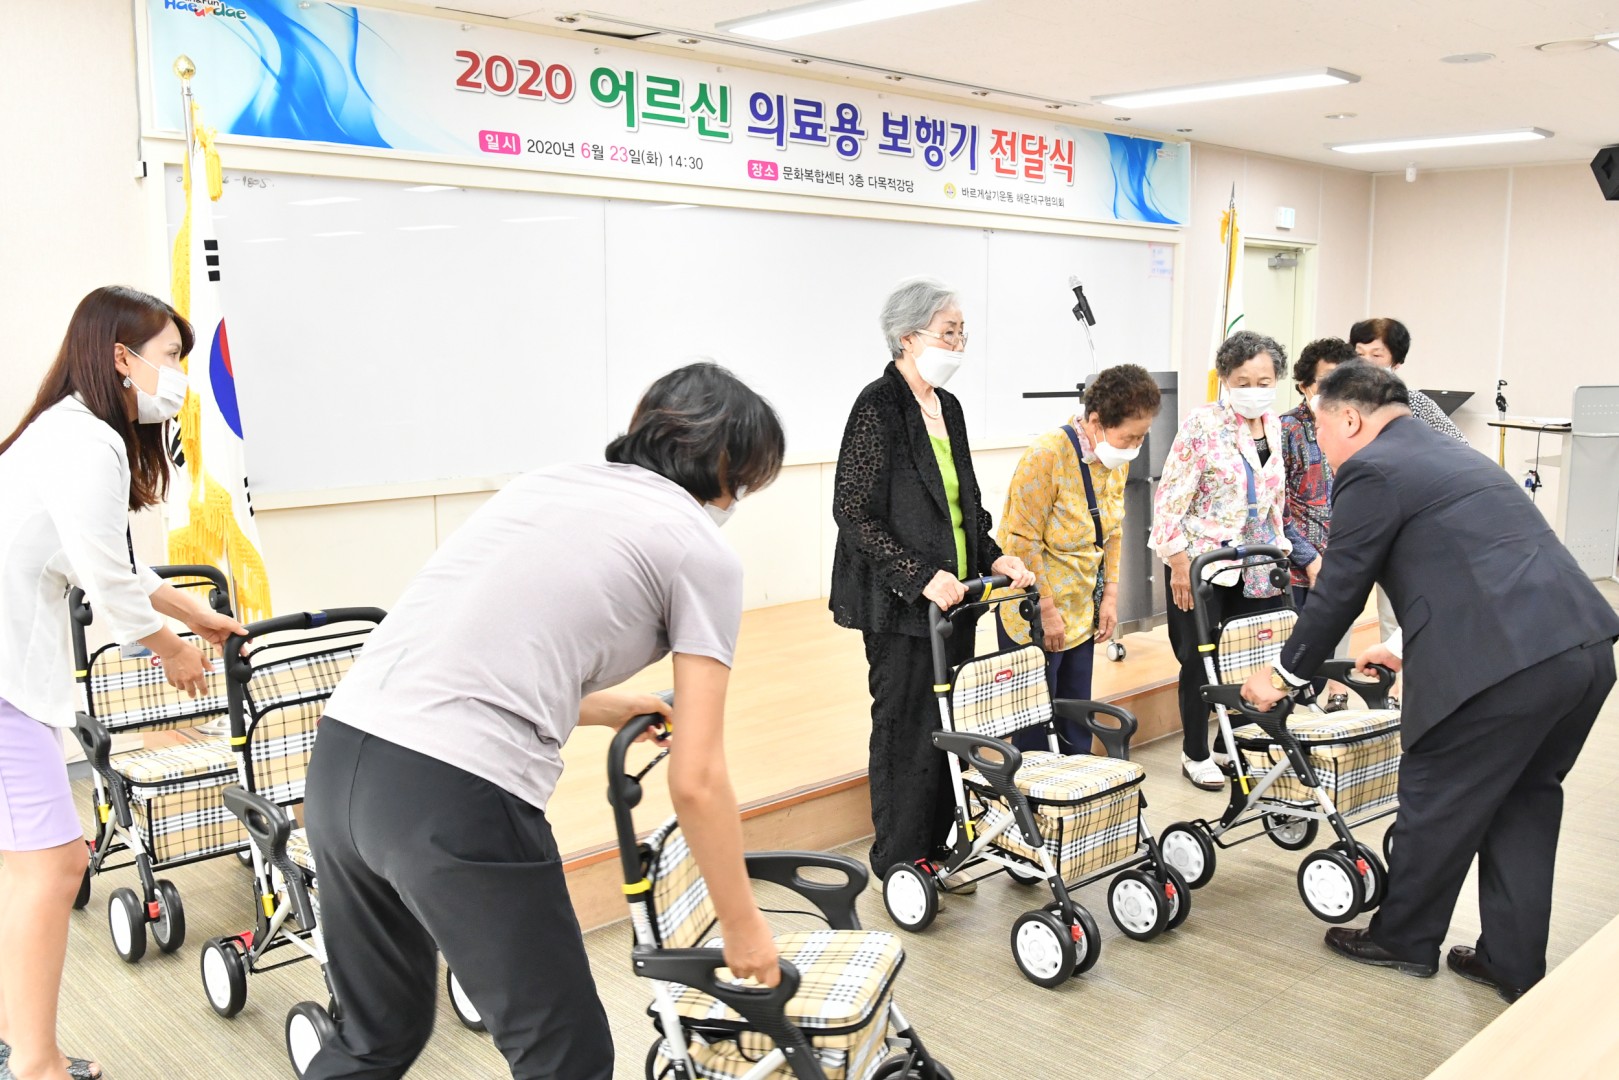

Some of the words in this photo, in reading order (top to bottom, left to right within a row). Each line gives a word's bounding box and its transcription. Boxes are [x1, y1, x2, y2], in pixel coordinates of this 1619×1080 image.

[455, 50, 574, 101] 2020
[590, 67, 730, 139] 어르신
[748, 92, 866, 157] 의료용
[878, 111, 977, 171] 보행기
[989, 128, 1076, 183] 전달식
[485, 133, 516, 153] 일시
[527, 139, 575, 158] 2020년
[581, 142, 604, 161] 6월
[610, 145, 663, 167] 23일(화)
[668, 155, 704, 170] 14:30
[751, 163, 776, 178] 장소
[783, 166, 845, 186] 문화복합센터
[848, 174, 864, 188] 3층
[868, 176, 914, 194] 다목적강당
